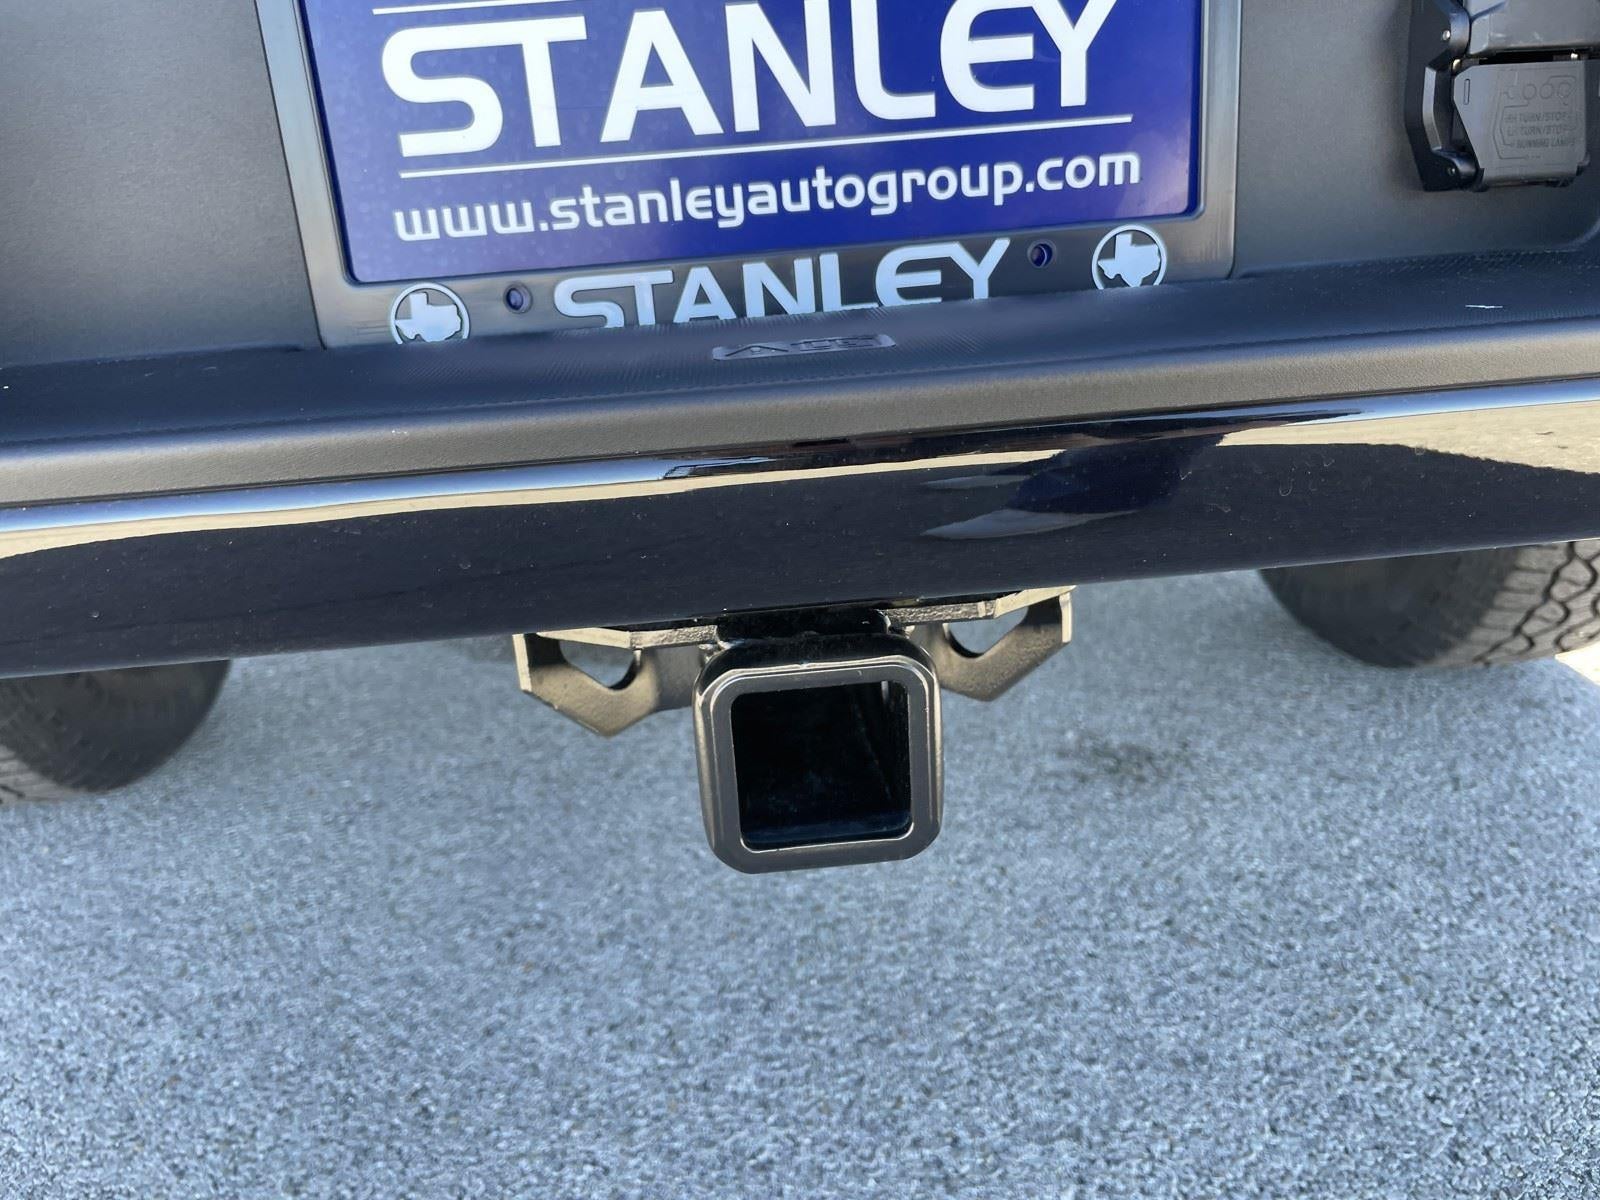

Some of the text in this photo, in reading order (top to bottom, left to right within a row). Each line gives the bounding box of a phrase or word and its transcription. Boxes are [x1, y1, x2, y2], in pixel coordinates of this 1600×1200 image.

[381, 0, 1118, 157] STANLEY
[394, 152, 1141, 241] www.stanleyautogroup.com
[554, 238, 1011, 328] STANLEY
